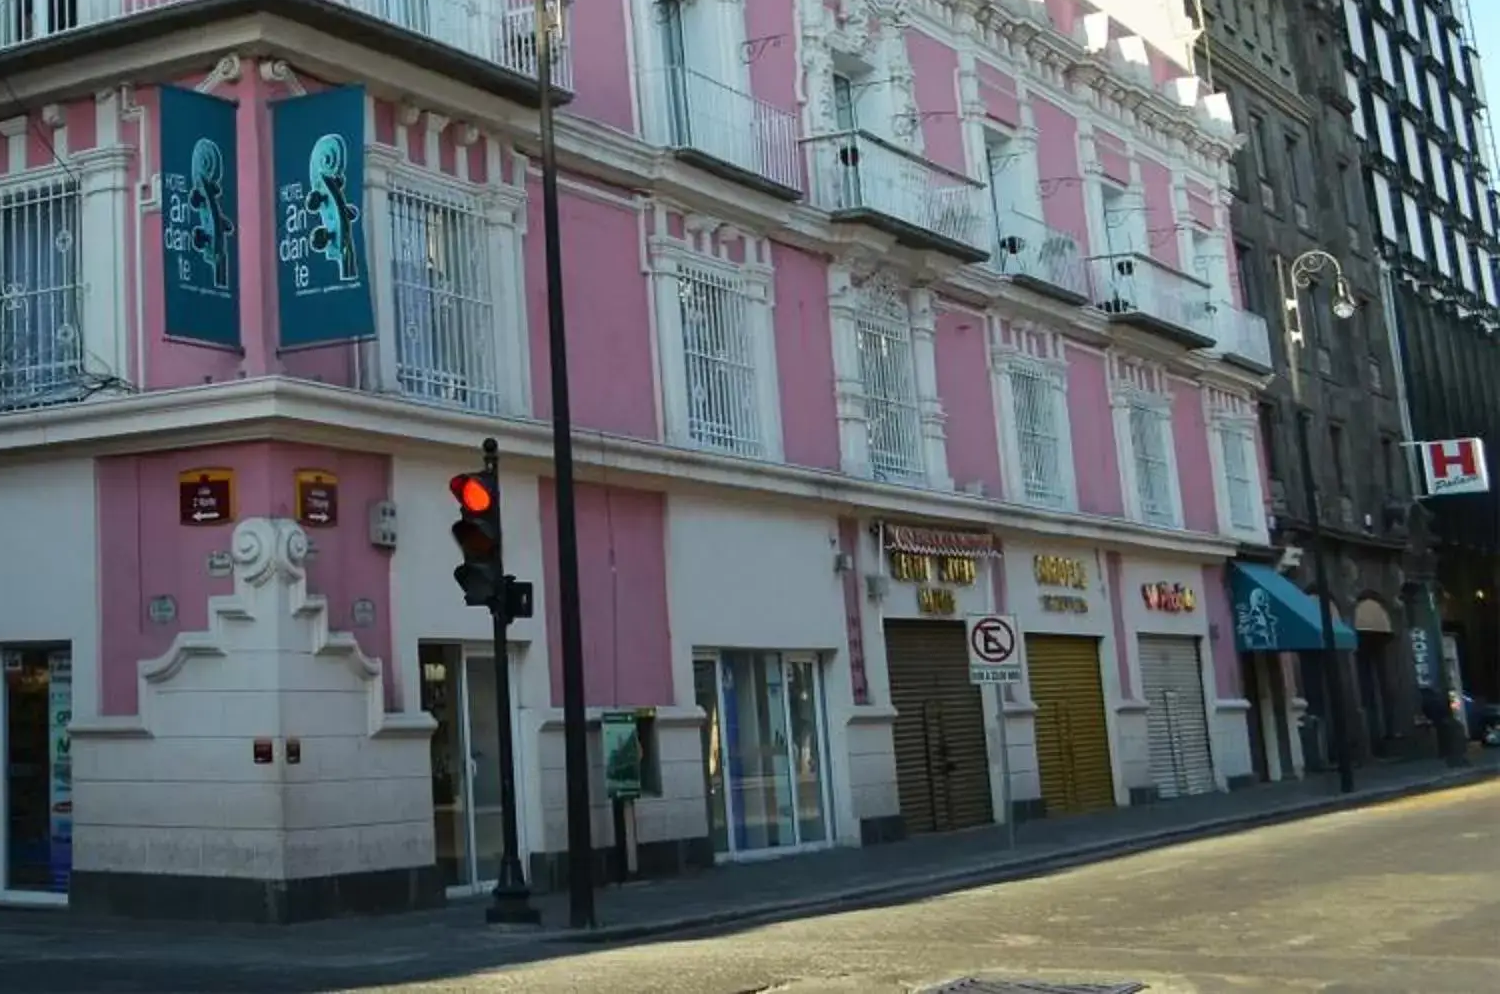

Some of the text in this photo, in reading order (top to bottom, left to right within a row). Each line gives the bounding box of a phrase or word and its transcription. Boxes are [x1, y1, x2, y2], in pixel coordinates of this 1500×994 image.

[165, 173, 187, 192] HOTEL
[280, 182, 304, 201] HOTEL
[169, 194, 191, 223] an
[285, 205, 307, 232] an
[164, 224, 191, 251] dan
[279, 235, 309, 262] dan
[177, 254, 191, 281] te
[294, 261, 309, 287] te
[1429, 441, 1477, 479] H
